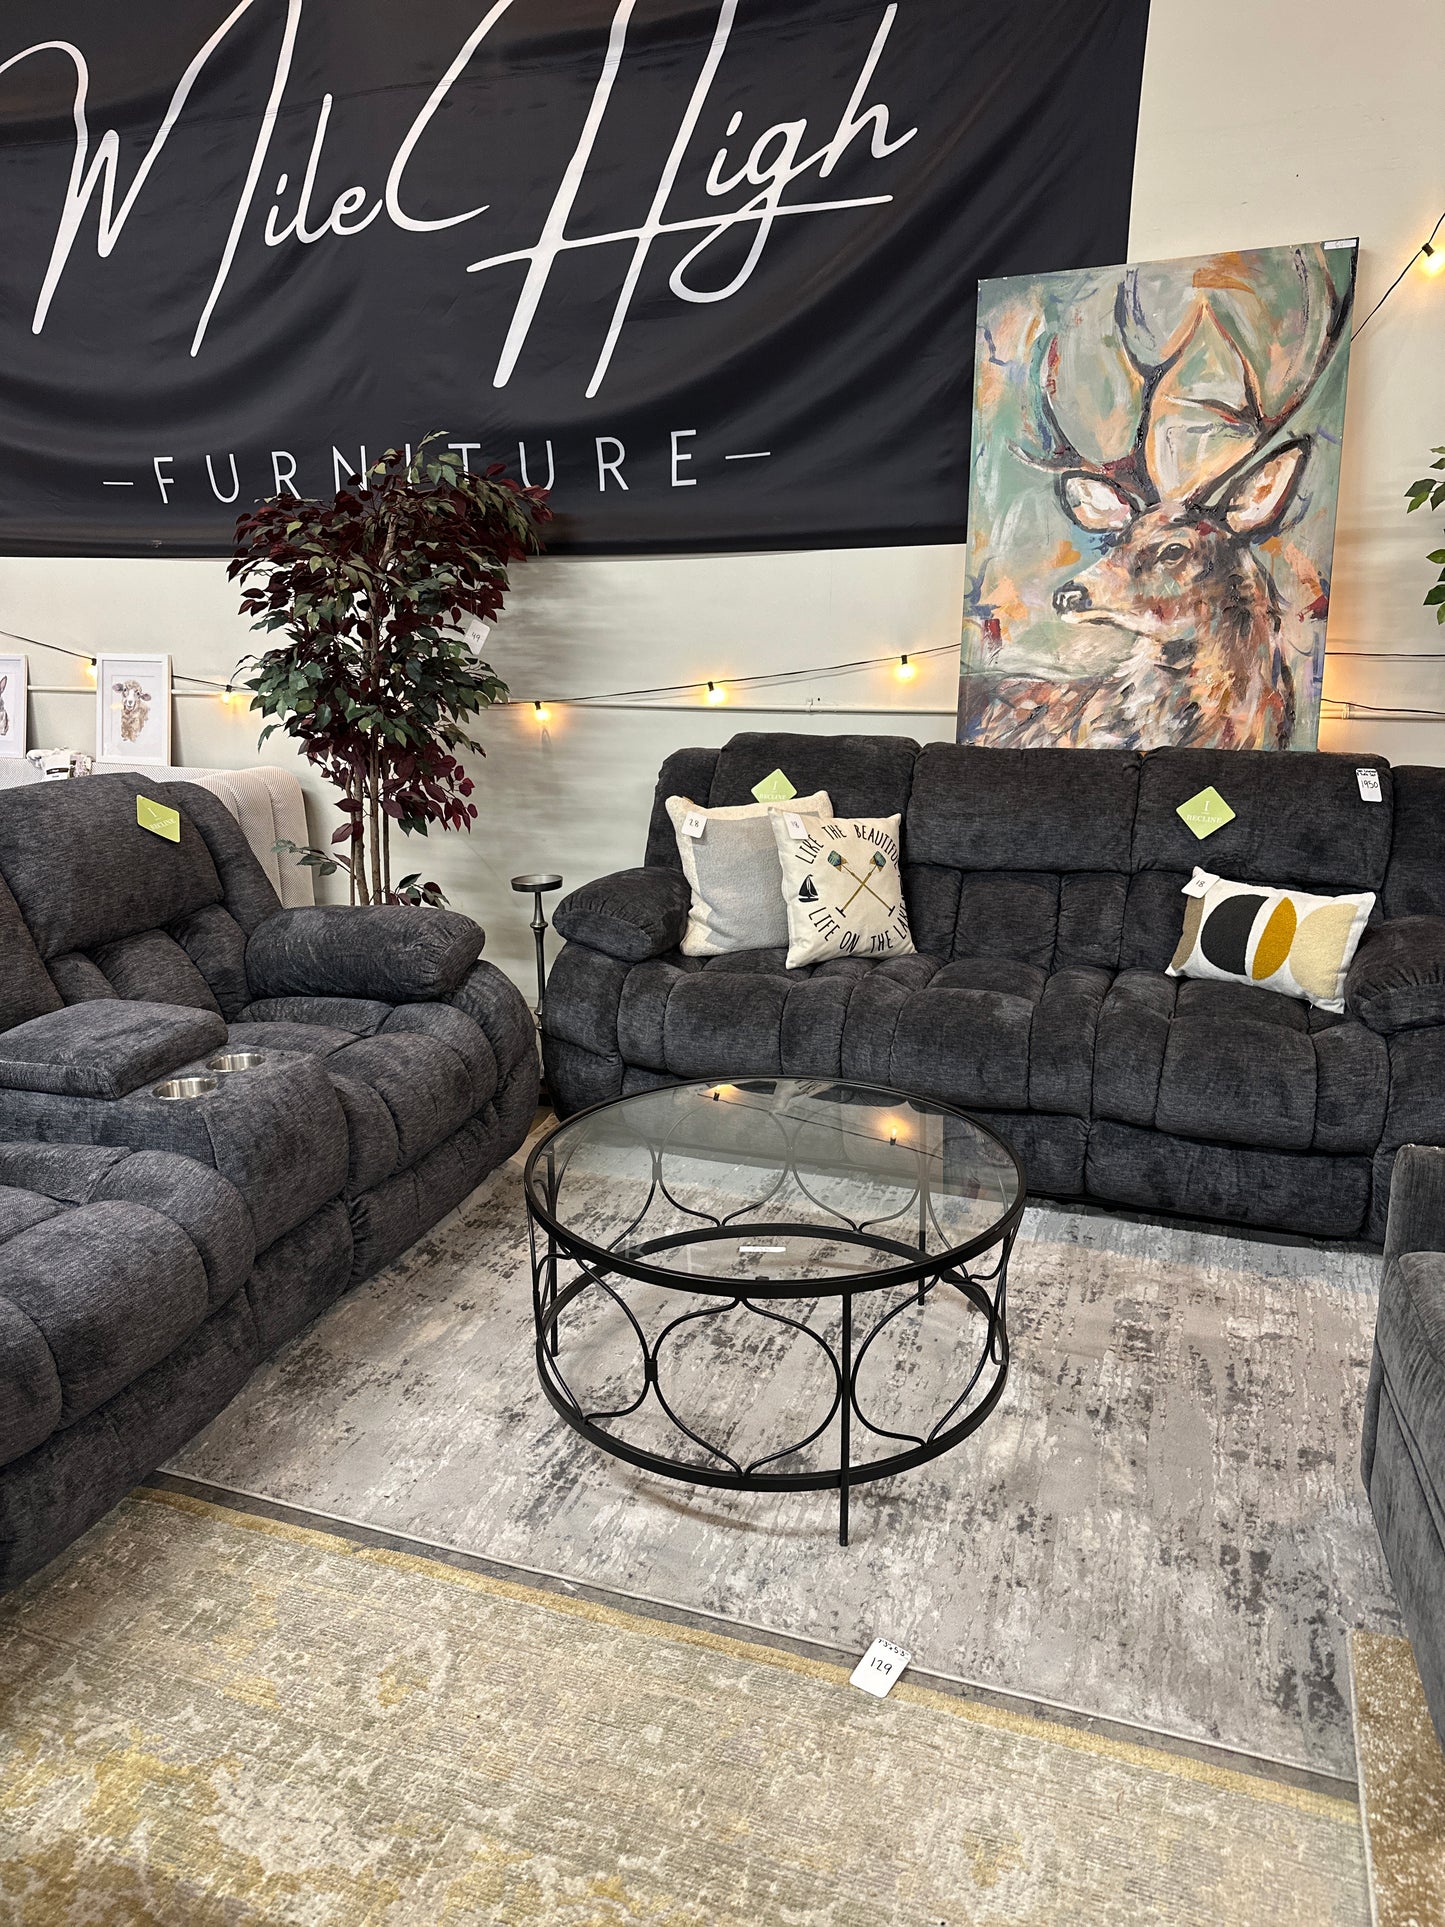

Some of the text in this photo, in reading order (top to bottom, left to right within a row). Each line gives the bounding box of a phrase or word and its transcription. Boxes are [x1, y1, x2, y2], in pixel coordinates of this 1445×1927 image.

[385, 0, 918, 399] High
[153, 429, 699, 504] FURNITURE
[471, 631, 481, 643] 49
[1360, 779, 1379, 789] 1950
[1204, 800, 1210, 812] I
[1186, 814, 1223, 824] RECLINE
[795, 834, 824, 864] LIKE
[821, 824, 847, 840] THE
[1195, 879, 1206, 888] 18
[808, 906, 841, 941] LIFE
[839, 930, 860, 953] ON
[870, 930, 894, 953] THE
[870, 1657, 893, 1675] 129
